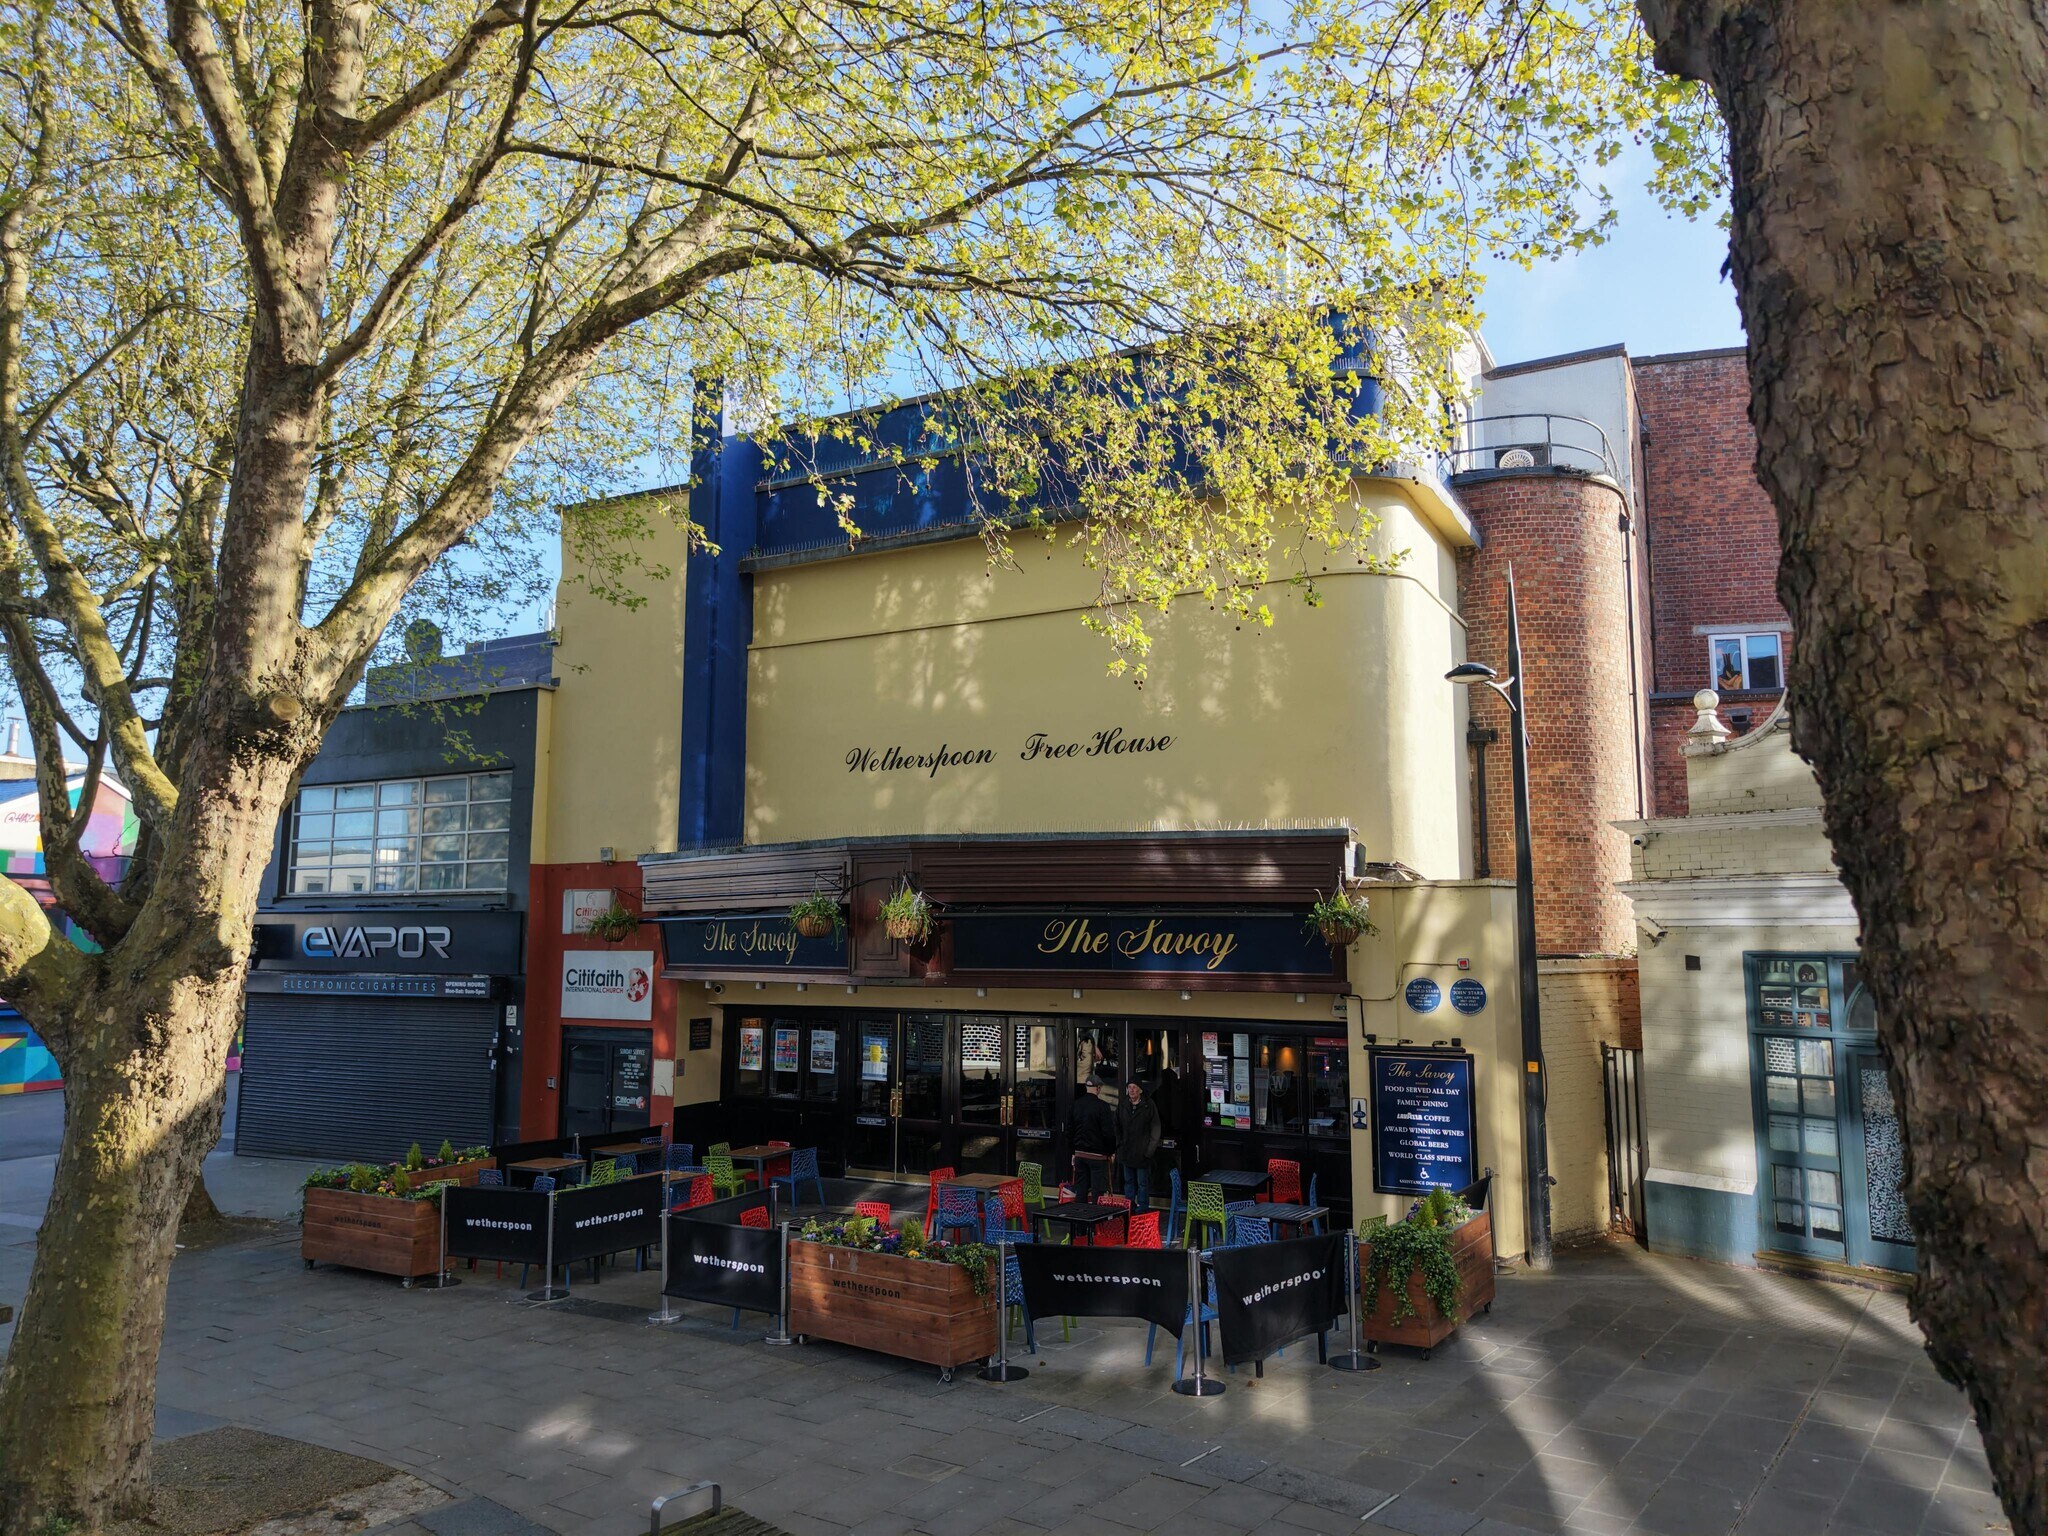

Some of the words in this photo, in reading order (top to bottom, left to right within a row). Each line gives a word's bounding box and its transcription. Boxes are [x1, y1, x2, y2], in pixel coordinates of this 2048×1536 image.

[845, 743, 997, 778] Wetherspoon
[1020, 733, 1084, 761] Free
[1086, 727, 1178, 757] House
[703, 921, 737, 951] The
[740, 920, 799, 965] Savoy
[1037, 919, 1109, 953] The
[1117, 919, 1238, 970] Savoy
[566, 968, 624, 987] Citifaith
[1388, 1062, 1411, 1078] The
[1415, 1063, 1456, 1085] Savoy
[1384, 1085, 1405, 1093] FOOD
[1405, 1086, 1432, 1094] SERVED
[1431, 1087, 1444, 1095] ALL
[1445, 1088, 1460, 1096] DAY
[1397, 1099, 1421, 1107] FAMILY
[1422, 1100, 1449, 1108] DINING
[1423, 1114, 1451, 1123] COFFEE
[1384, 1125, 1408, 1133] AWARD
[1408, 1127, 1441, 1135] WINNING
[1441, 1129, 1465, 1137] WINES
[1399, 1139, 1427, 1148] GLOBAL
[1428, 1141, 1449, 1149] BEERS
[1388, 1151, 1414, 1159] WORLD
[1414, 1153, 1435, 1161] CLASS
[1436, 1154, 1462, 1163] SPIRITS
[466, 1218, 532, 1231] wetherspoon
[575, 1208, 644, 1229] wetherspoon
[694, 1254, 765, 1274] wetherspoon
[1053, 1273, 1162, 1287] wetherspoon
[833, 1278, 901, 1299] wetherspoon
